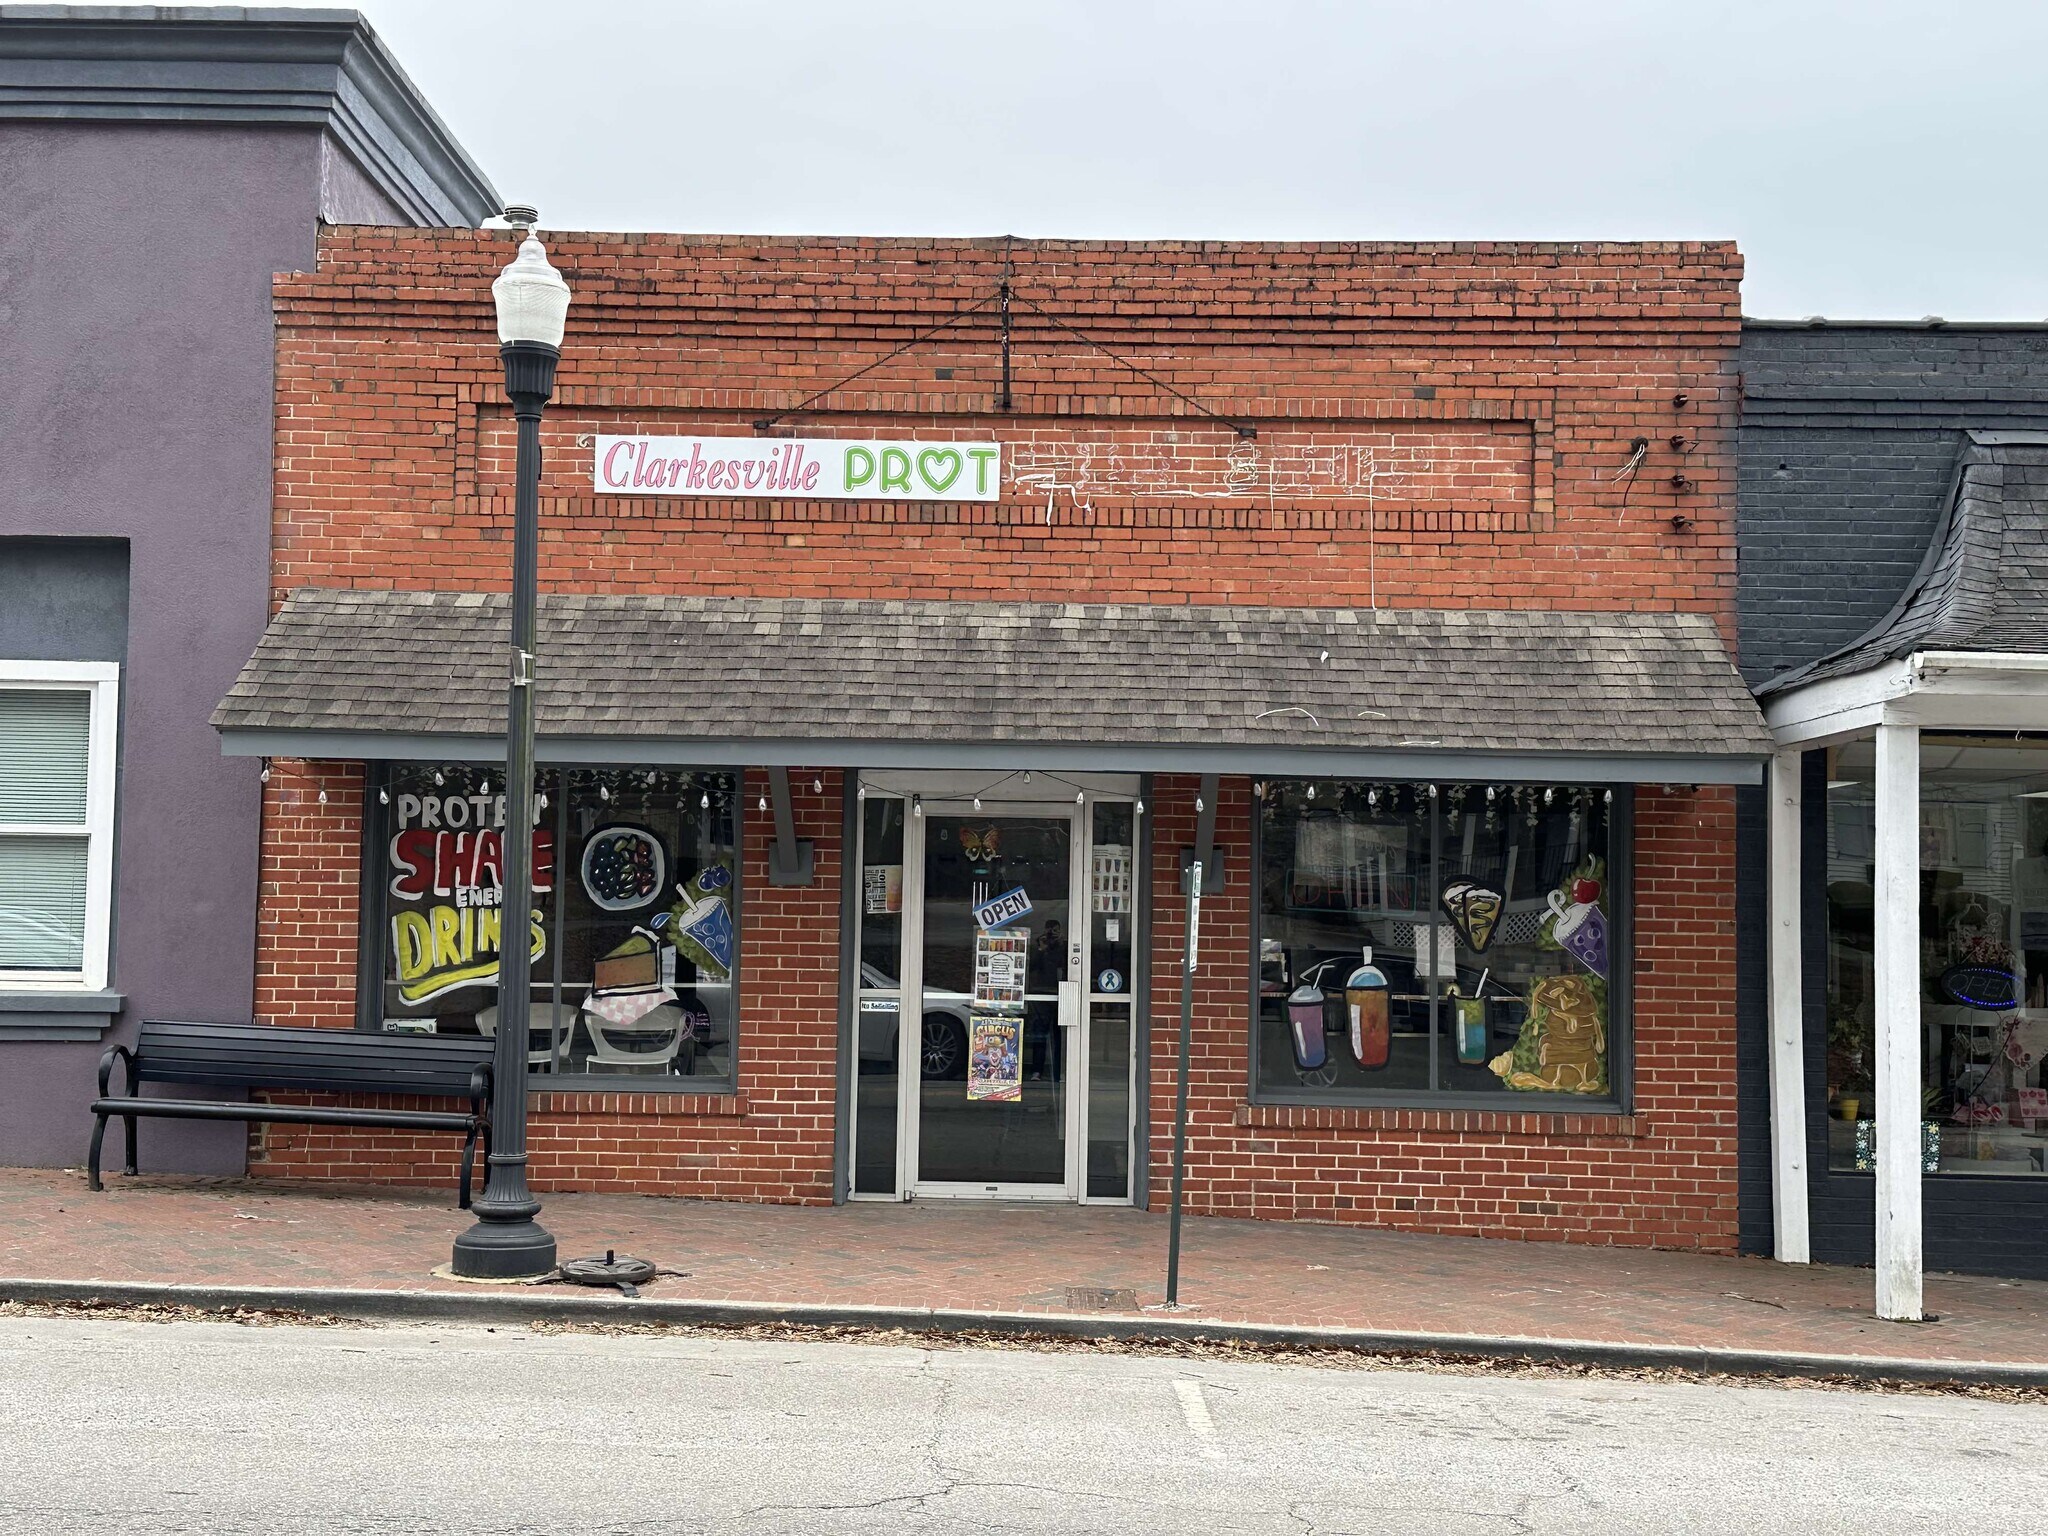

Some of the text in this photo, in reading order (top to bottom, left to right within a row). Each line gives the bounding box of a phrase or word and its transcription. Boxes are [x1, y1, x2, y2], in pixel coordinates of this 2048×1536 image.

[603, 440, 820, 491] Clarkesville
[397, 794, 541, 829] PROTE
[389, 829, 553, 900] SHAE
[981, 892, 1027, 926] OPEN
[392, 905, 546, 980] DRINS
[976, 1025, 1016, 1040] CIRCUS
